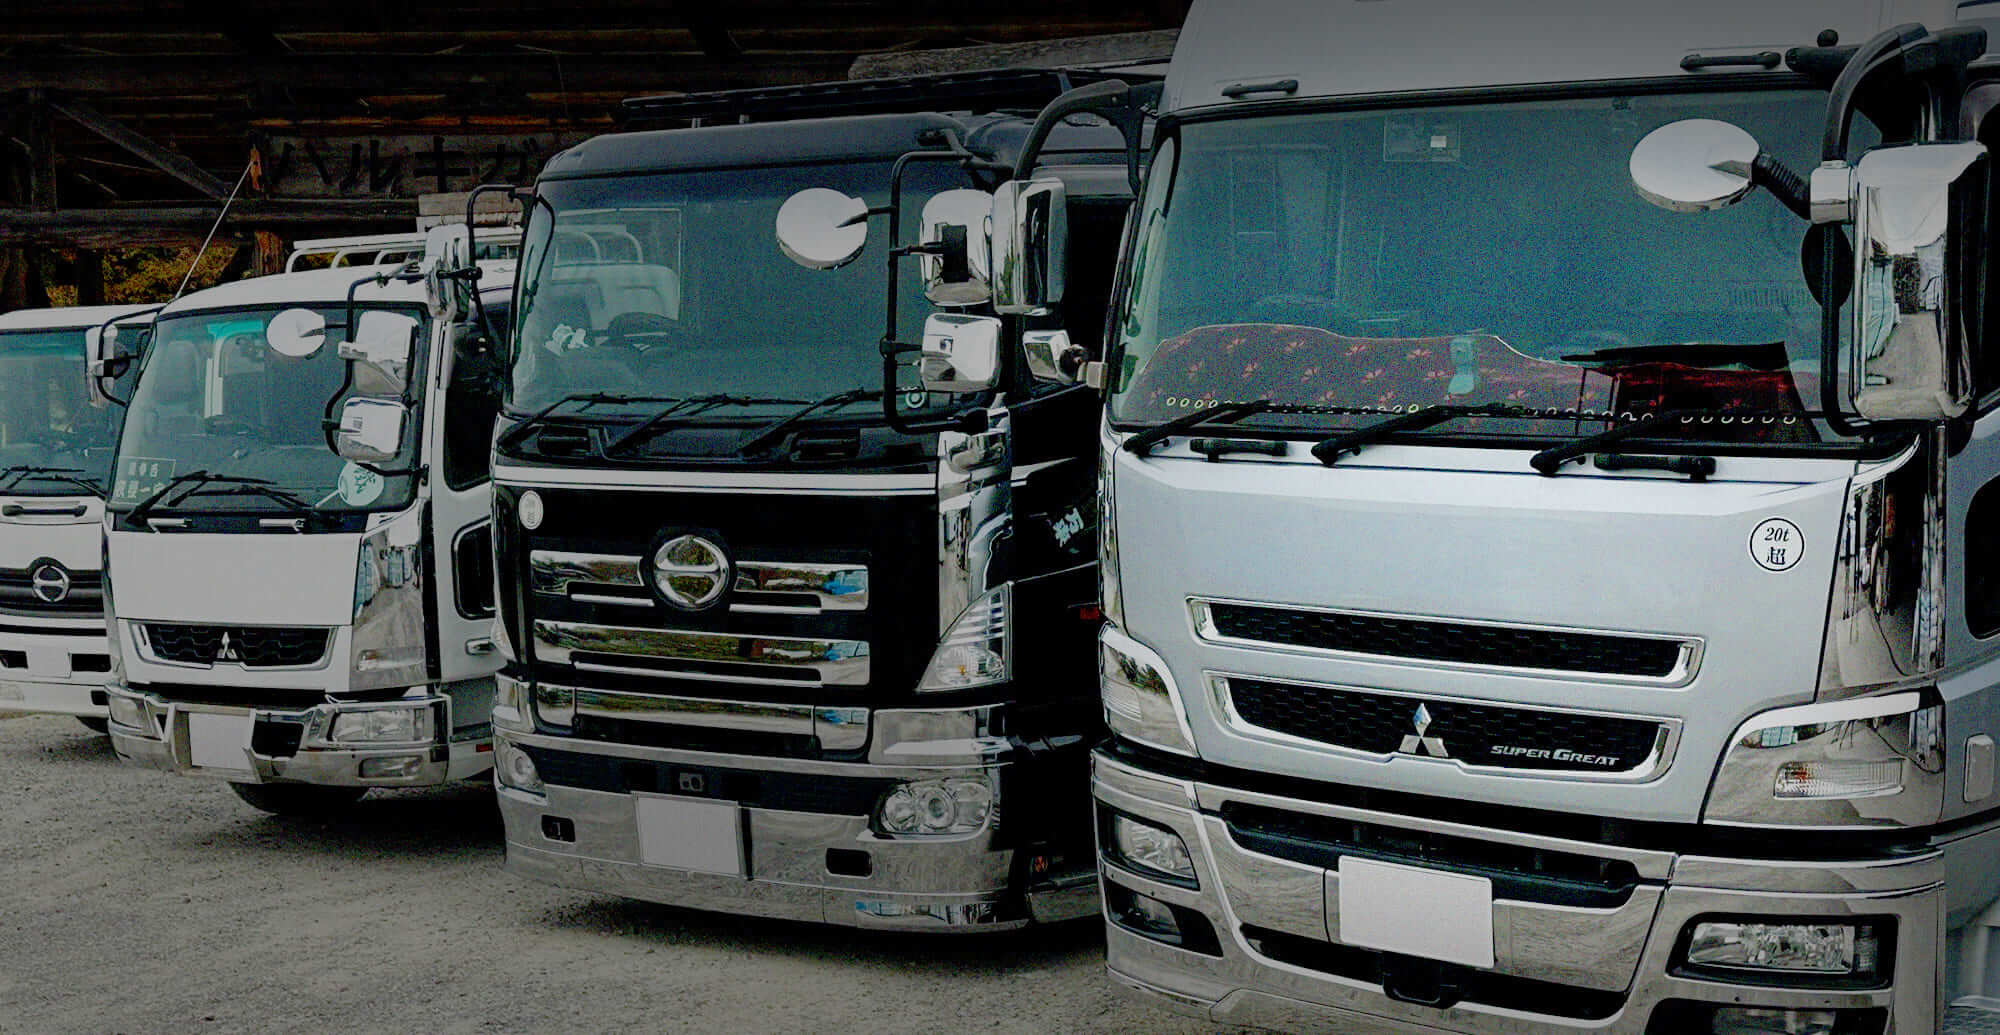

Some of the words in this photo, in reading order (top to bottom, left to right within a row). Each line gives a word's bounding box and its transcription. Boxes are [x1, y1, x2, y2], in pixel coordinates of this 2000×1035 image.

[271, 136, 545, 192] ハルキガ
[1764, 527, 1790, 542] 20t
[1490, 745, 1551, 759] SUPER
[1552, 748, 1620, 767] GREAT
